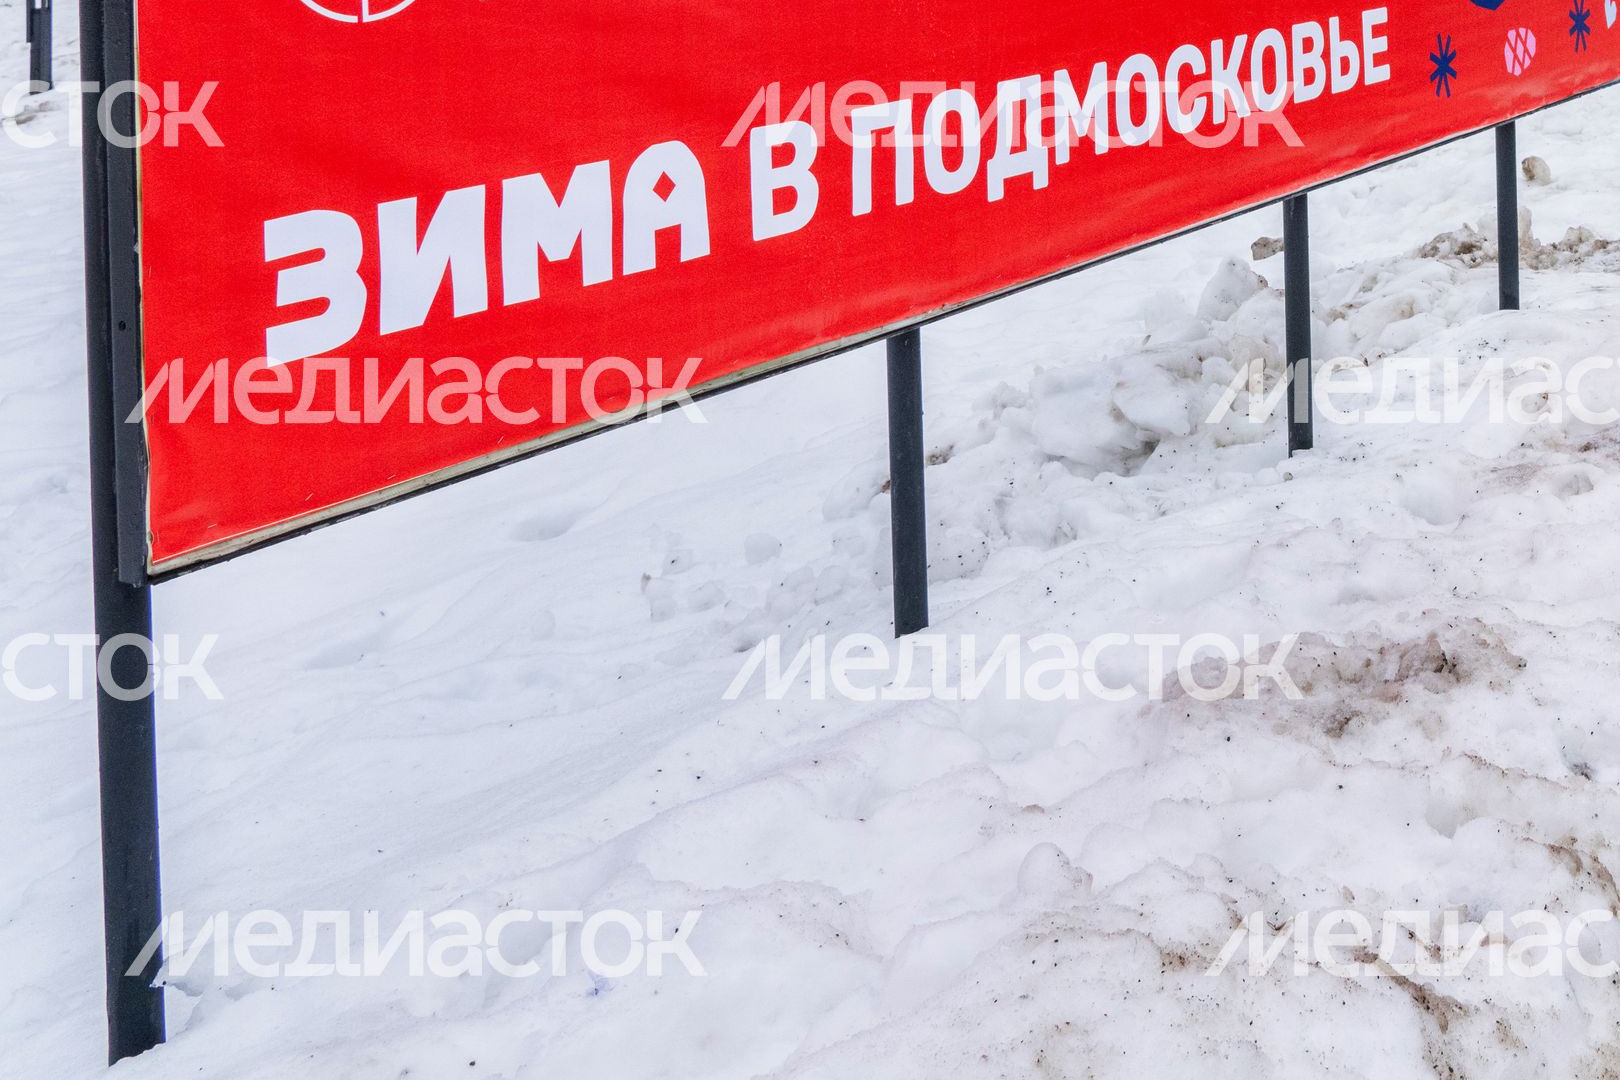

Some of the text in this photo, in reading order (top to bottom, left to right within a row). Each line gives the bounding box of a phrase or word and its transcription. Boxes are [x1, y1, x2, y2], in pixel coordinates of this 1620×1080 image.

[264, 7, 1391, 368] ЗИМА В ПОДМОСКОВЬЕ
